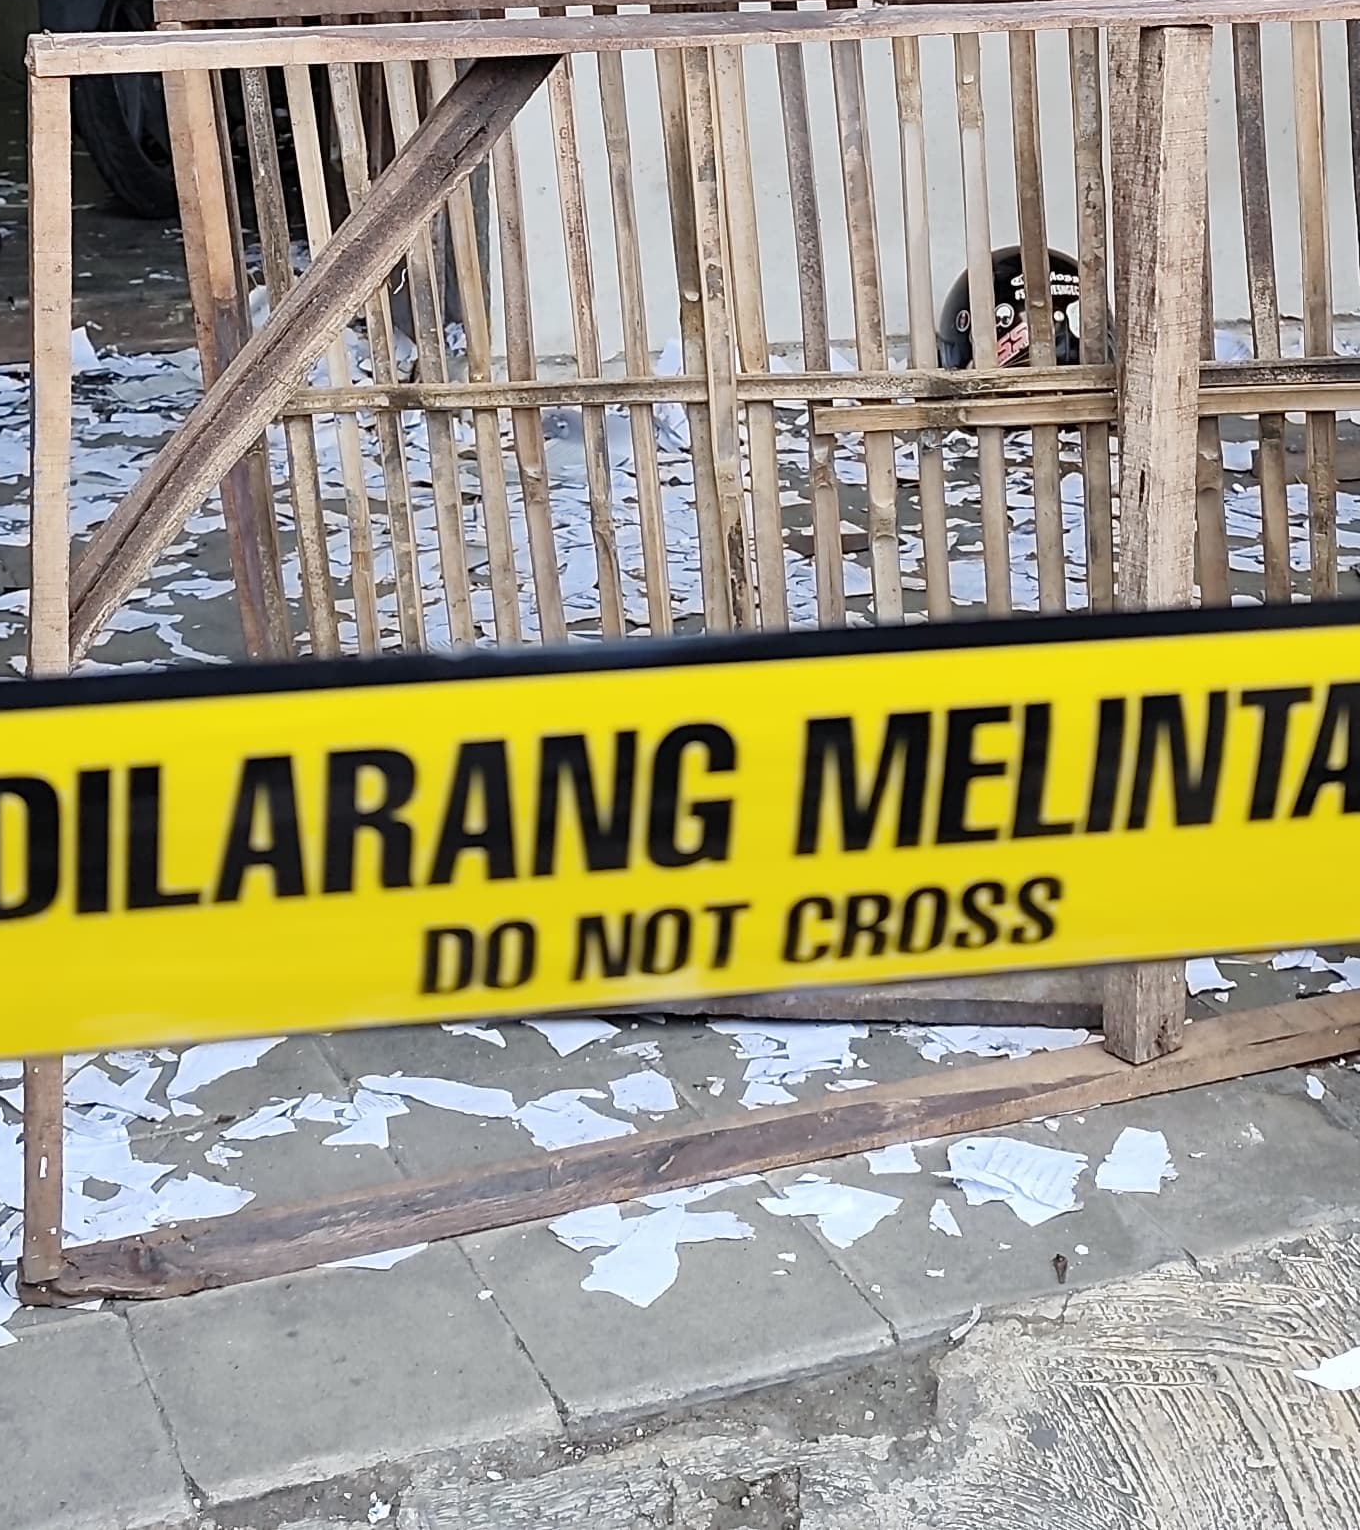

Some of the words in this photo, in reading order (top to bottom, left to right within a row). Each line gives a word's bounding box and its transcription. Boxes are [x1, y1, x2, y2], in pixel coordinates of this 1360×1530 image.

[420, 920, 537, 996] DO
[571, 903, 750, 983] NOT
[782, 875, 1064, 965] CROSS
